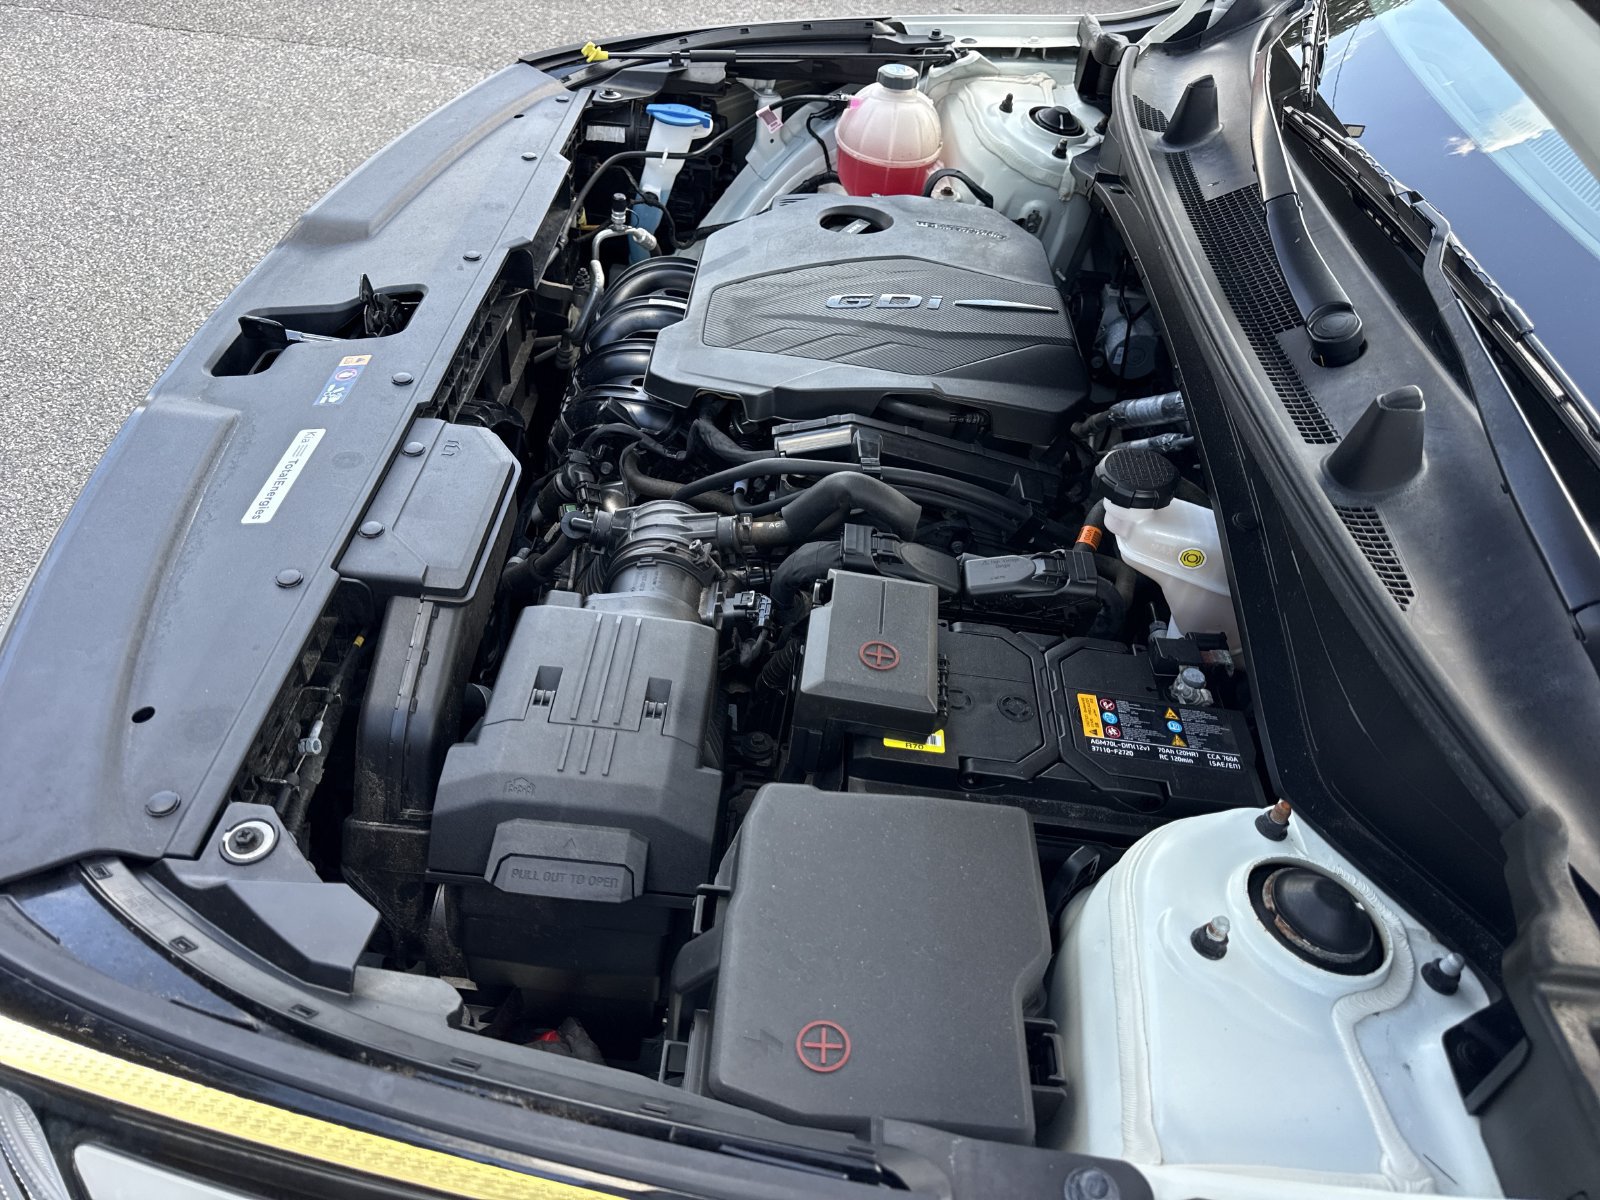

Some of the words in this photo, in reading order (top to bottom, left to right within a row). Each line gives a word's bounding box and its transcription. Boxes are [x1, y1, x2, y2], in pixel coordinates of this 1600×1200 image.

[825, 293, 943, 310] GDi
[301, 431, 318, 444] Kia
[252, 459, 299, 520] TotalEnergies
[1091, 745, 1134, 757] 37110-F2720
[1157, 746, 1175, 755] 70Ah
[1176, 748, 1199, 758] (20HR)
[1158, 753, 1169, 761] RC
[1170, 755, 1194, 764] 120min
[1206, 753, 1221, 761] CCA
[1222, 755, 1239, 763] 760A
[512, 868, 539, 881] PULL
[542, 871, 567, 882] OUT
[570, 873, 585, 885] TO
[588, 875, 619, 889] OPEN
